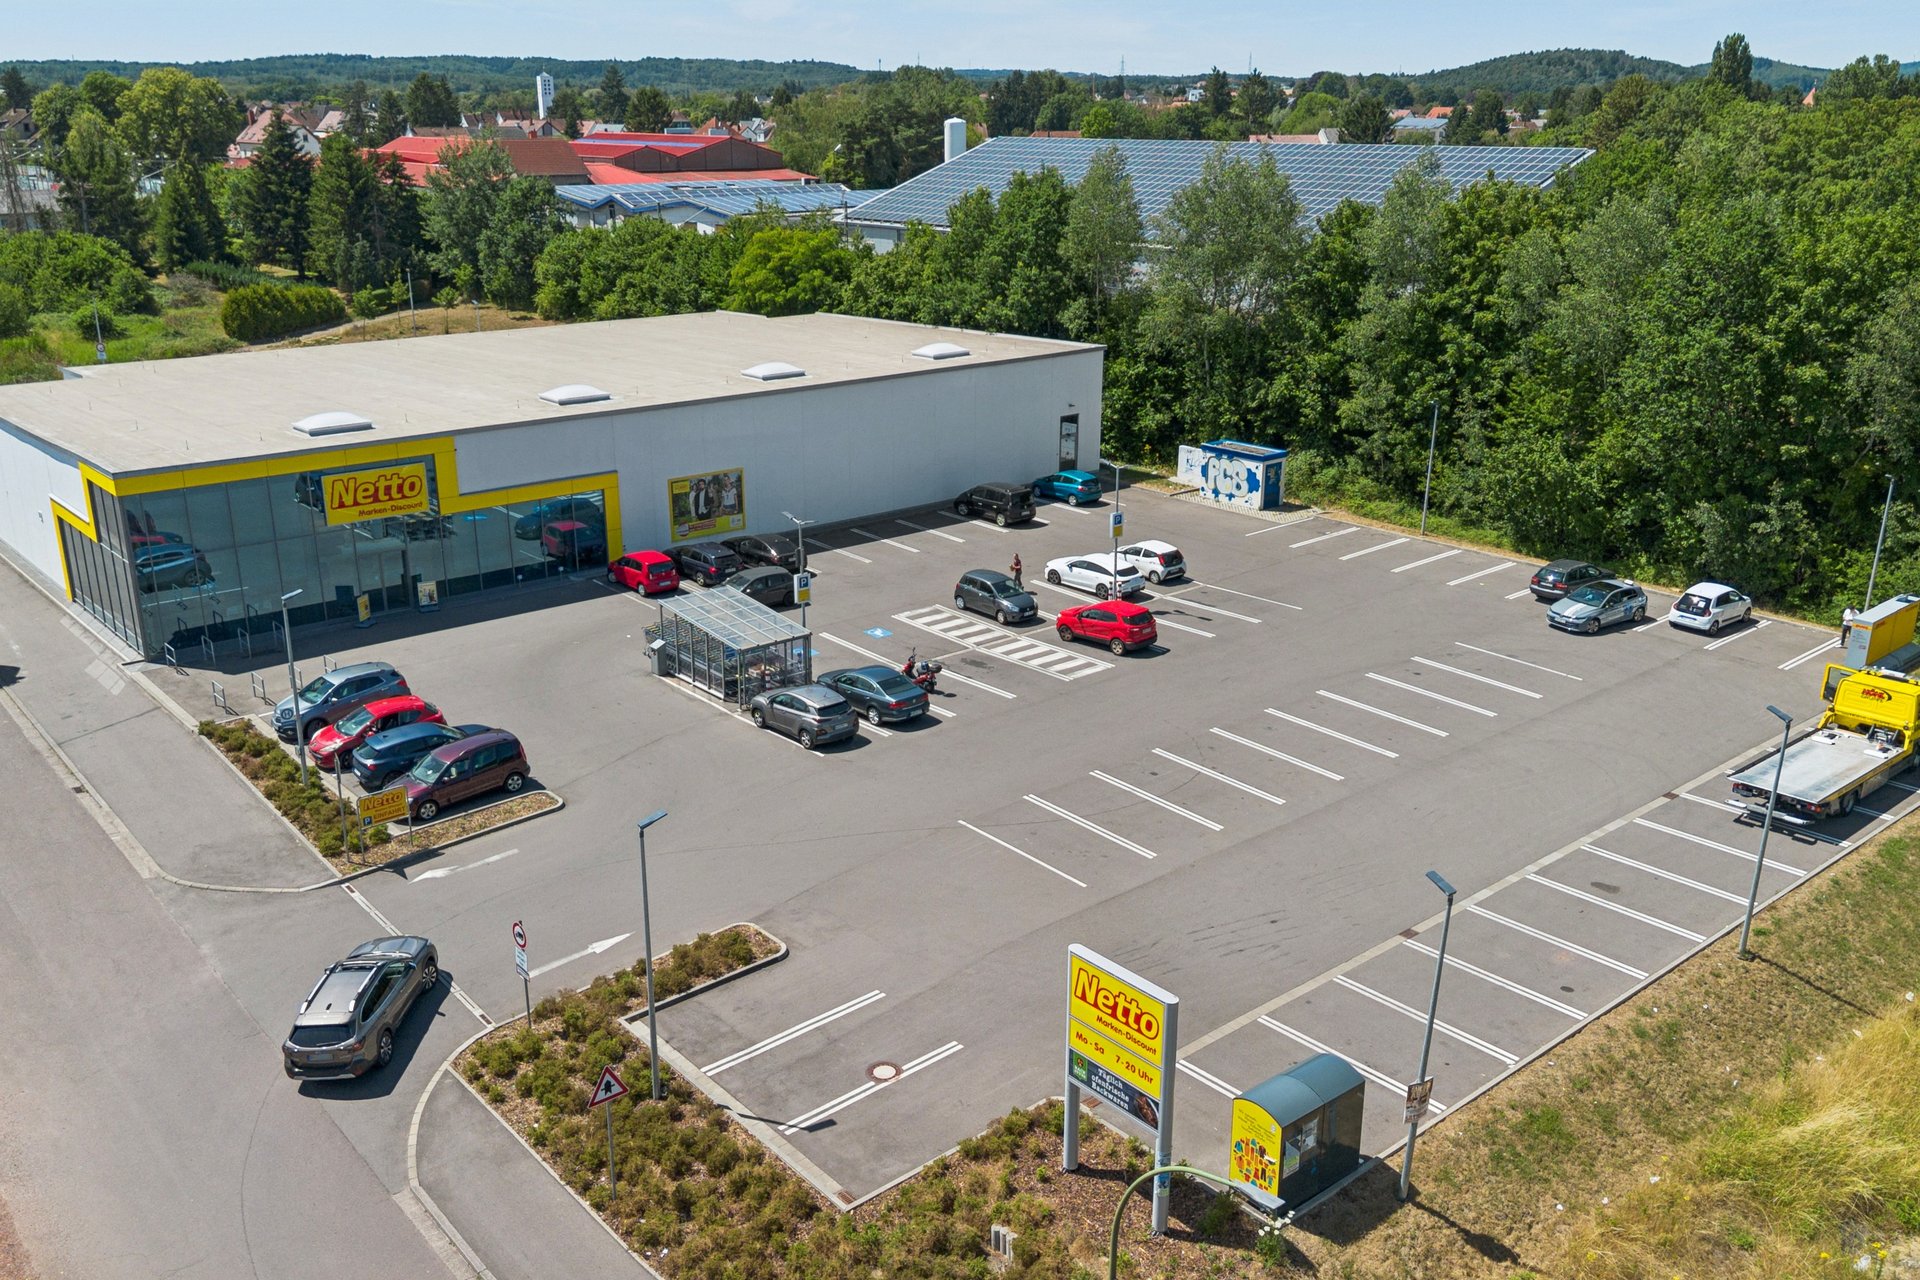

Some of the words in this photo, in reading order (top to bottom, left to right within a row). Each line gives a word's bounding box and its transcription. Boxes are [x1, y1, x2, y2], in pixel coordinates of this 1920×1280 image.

[331, 473, 422, 509] Netto
[800, 578, 807, 587] P
[363, 792, 402, 811] Netto
[1074, 968, 1159, 1040] Netto
[1096, 1014, 1157, 1055] Marken-Discount
[1075, 1031, 1088, 1045] Mo
[1094, 1042, 1105, 1055] Sa
[1137, 1069, 1154, 1085] Uhr
